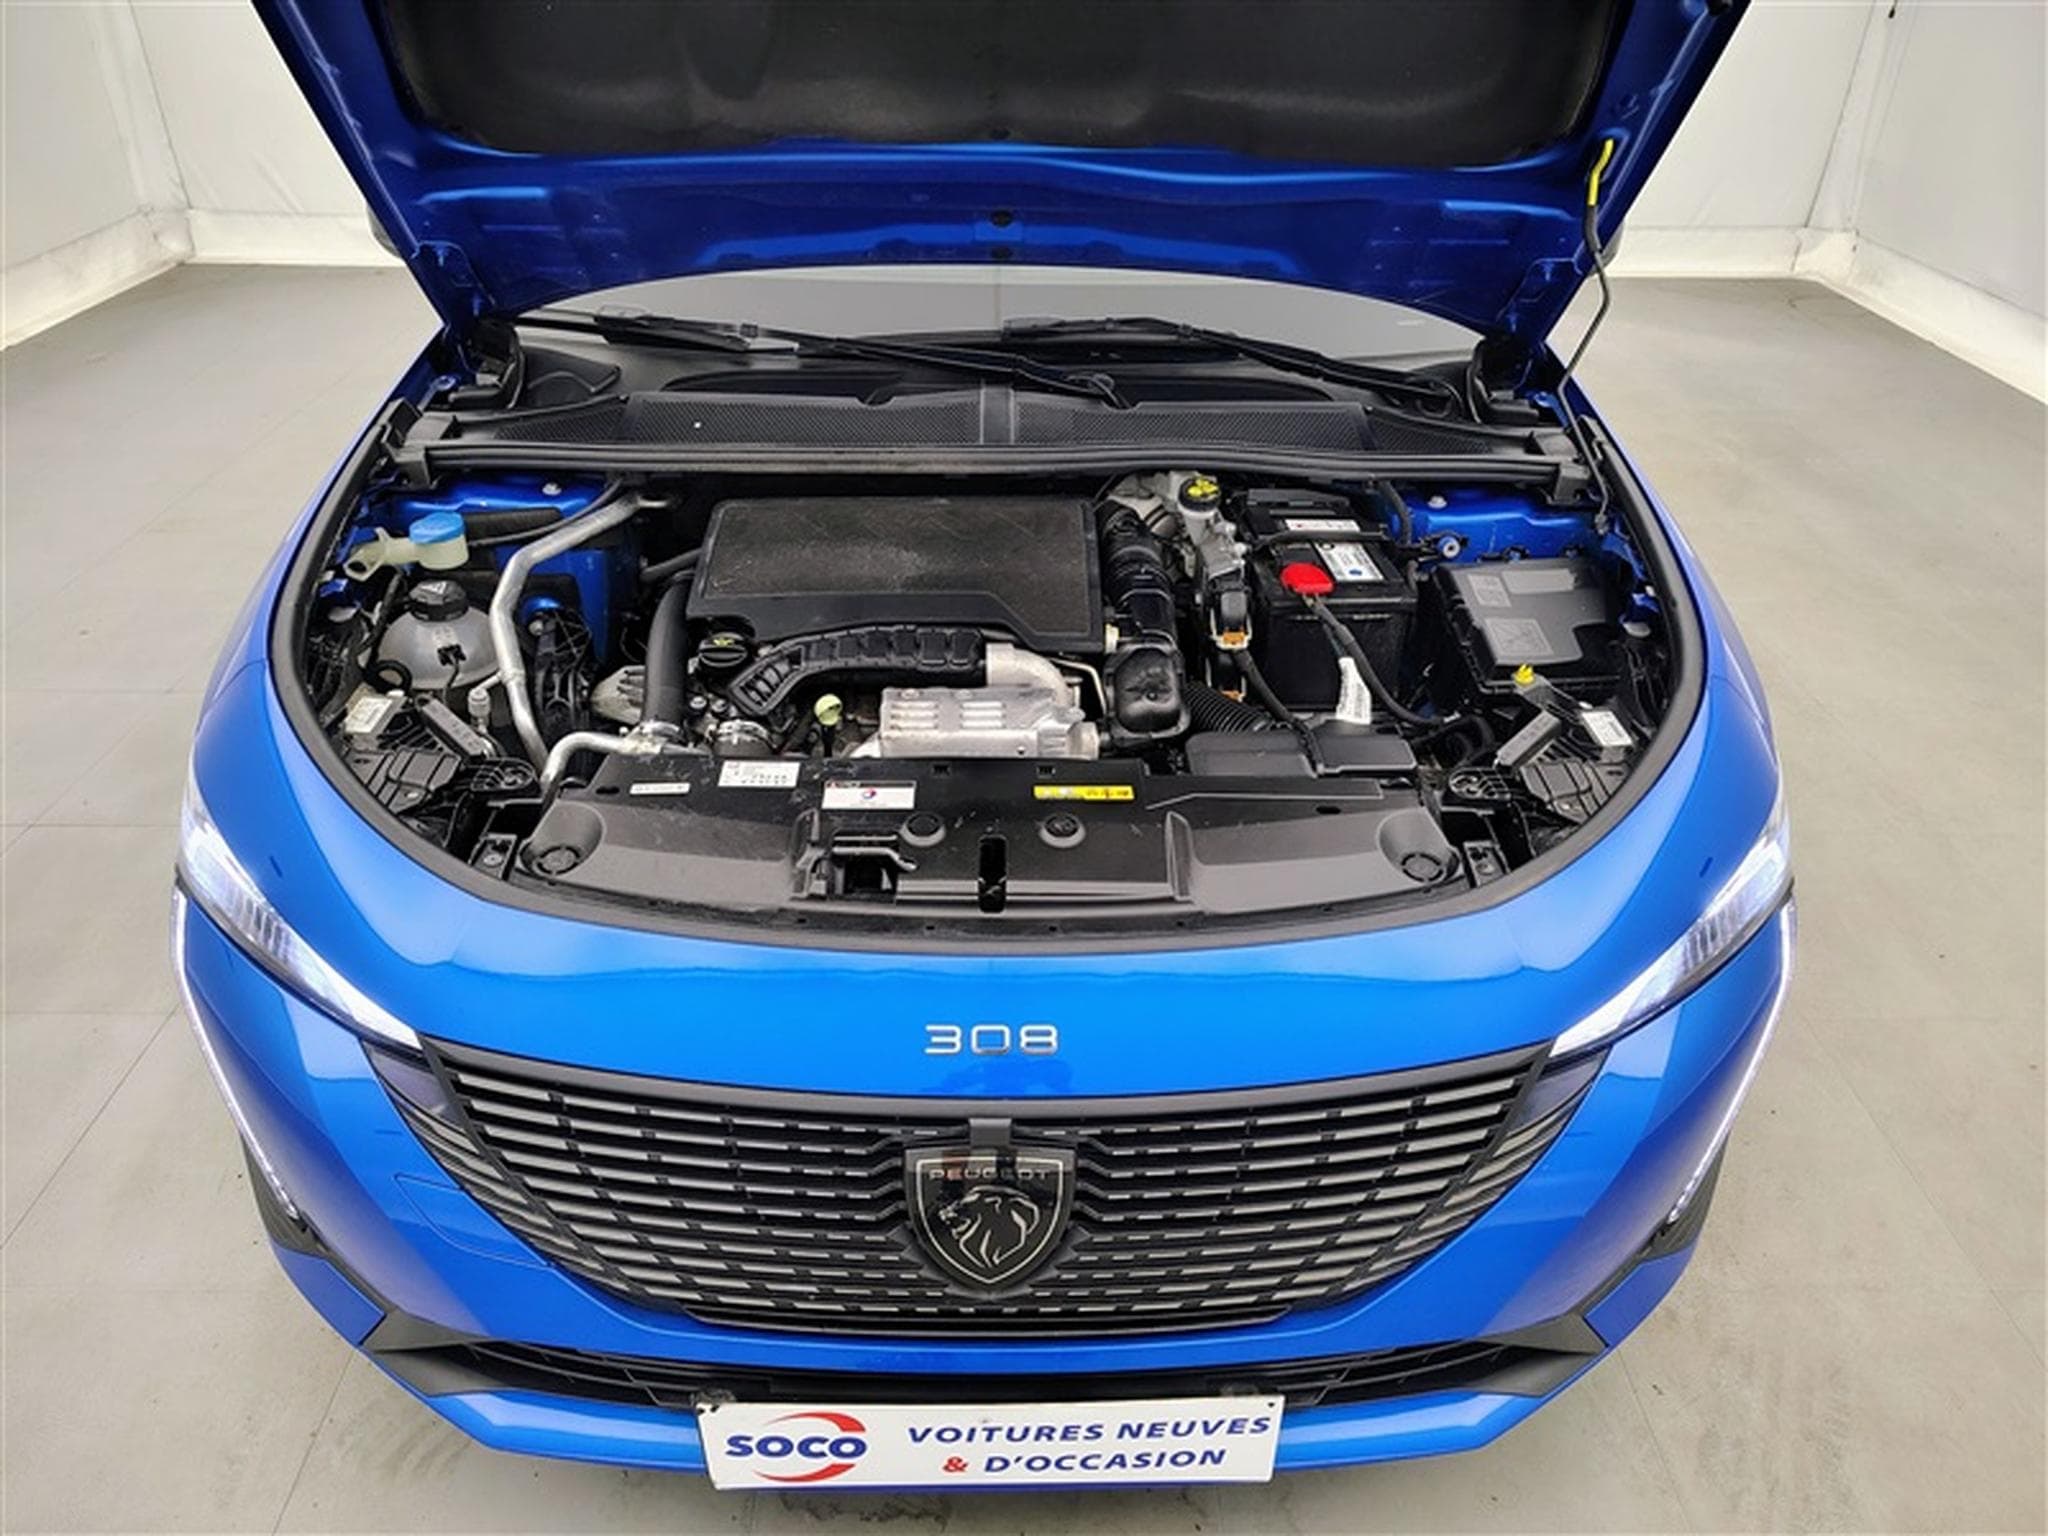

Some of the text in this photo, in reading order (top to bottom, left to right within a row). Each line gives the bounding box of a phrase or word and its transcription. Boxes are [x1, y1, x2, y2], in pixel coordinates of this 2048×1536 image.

[924, 1024, 1059, 1054] 308
[908, 1417, 1271, 1443] VOITURES NEUVES
[725, 1435, 868, 1459] SOCO
[943, 1449, 1227, 1473] & D'OCCASION
